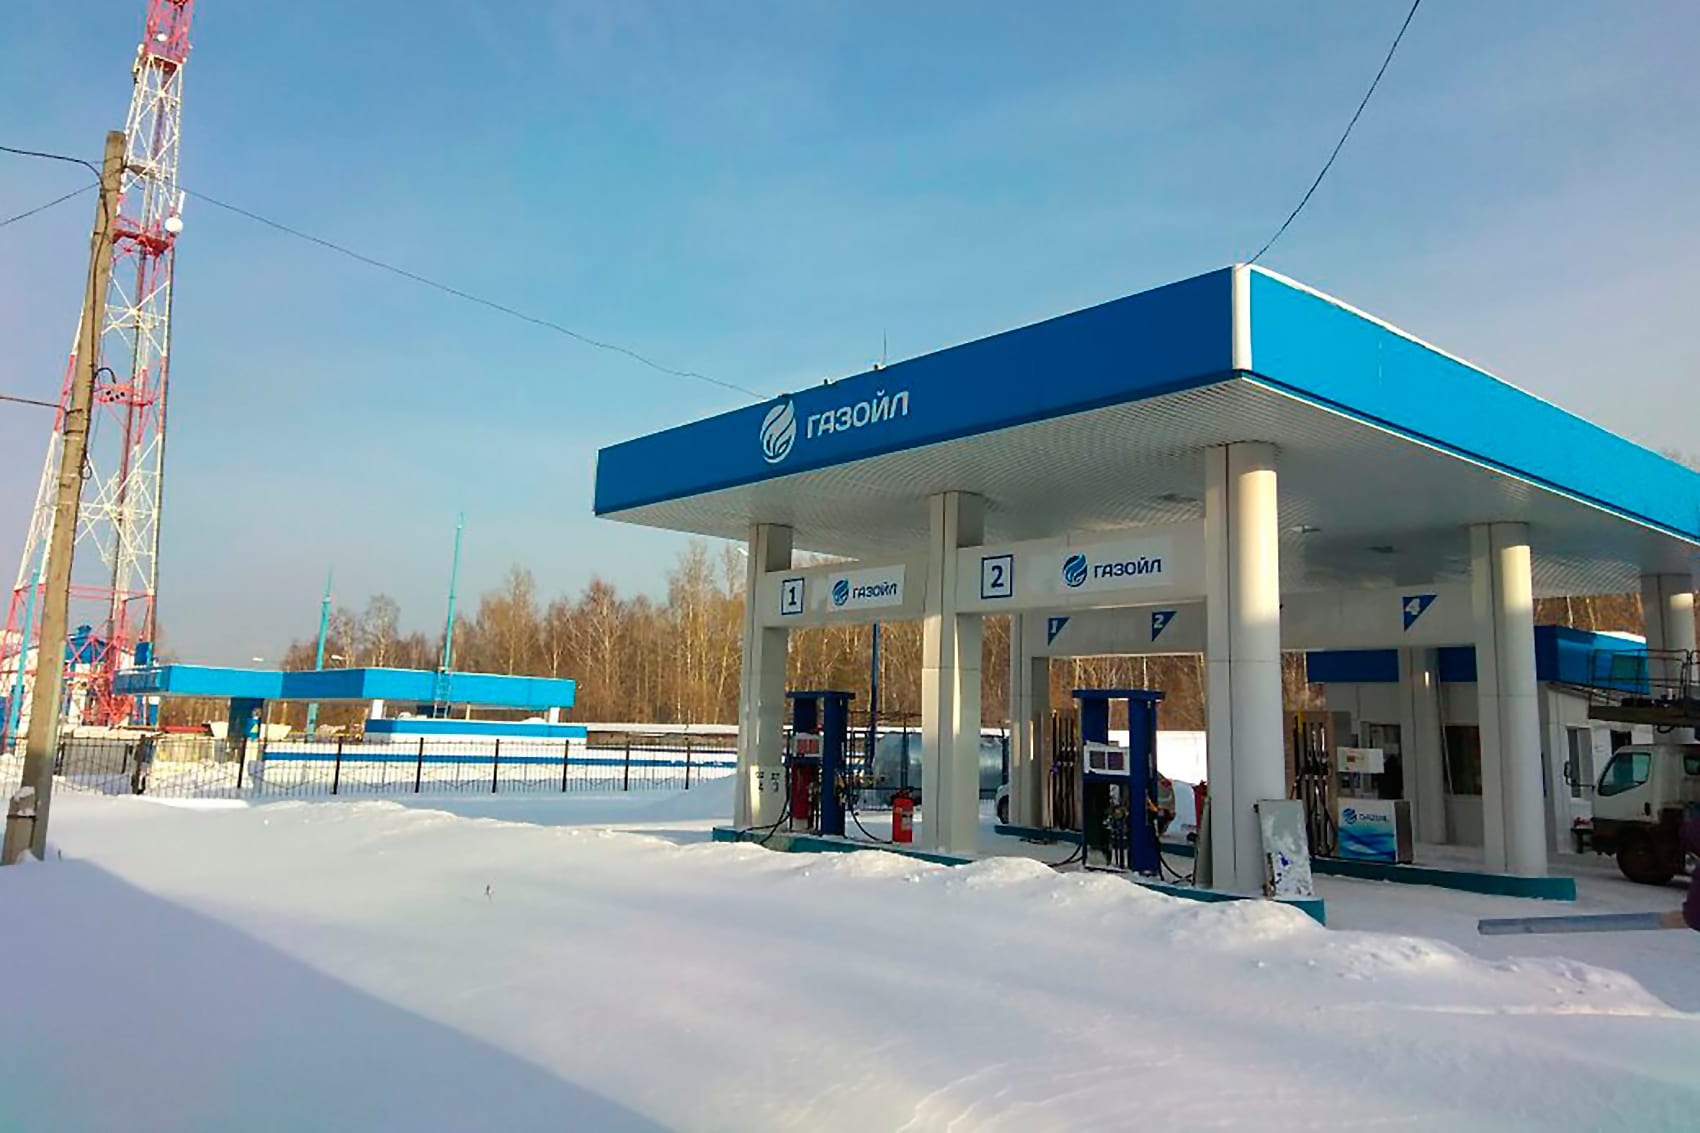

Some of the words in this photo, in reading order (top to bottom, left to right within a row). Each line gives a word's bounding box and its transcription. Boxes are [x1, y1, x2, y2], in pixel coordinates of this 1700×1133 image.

[807, 389, 909, 439] ГАЗОЙЛ
[991, 565, 1004, 588] 2
[1094, 556, 1161, 578] ГАЗОЙЛ
[788, 586, 797, 606] 1
[853, 581, 897, 599] ГАЗОЙЛ
[1405, 598, 1420, 615] 4
[1050, 619, 1058, 634] 1
[1153, 614, 1165, 629] 2
